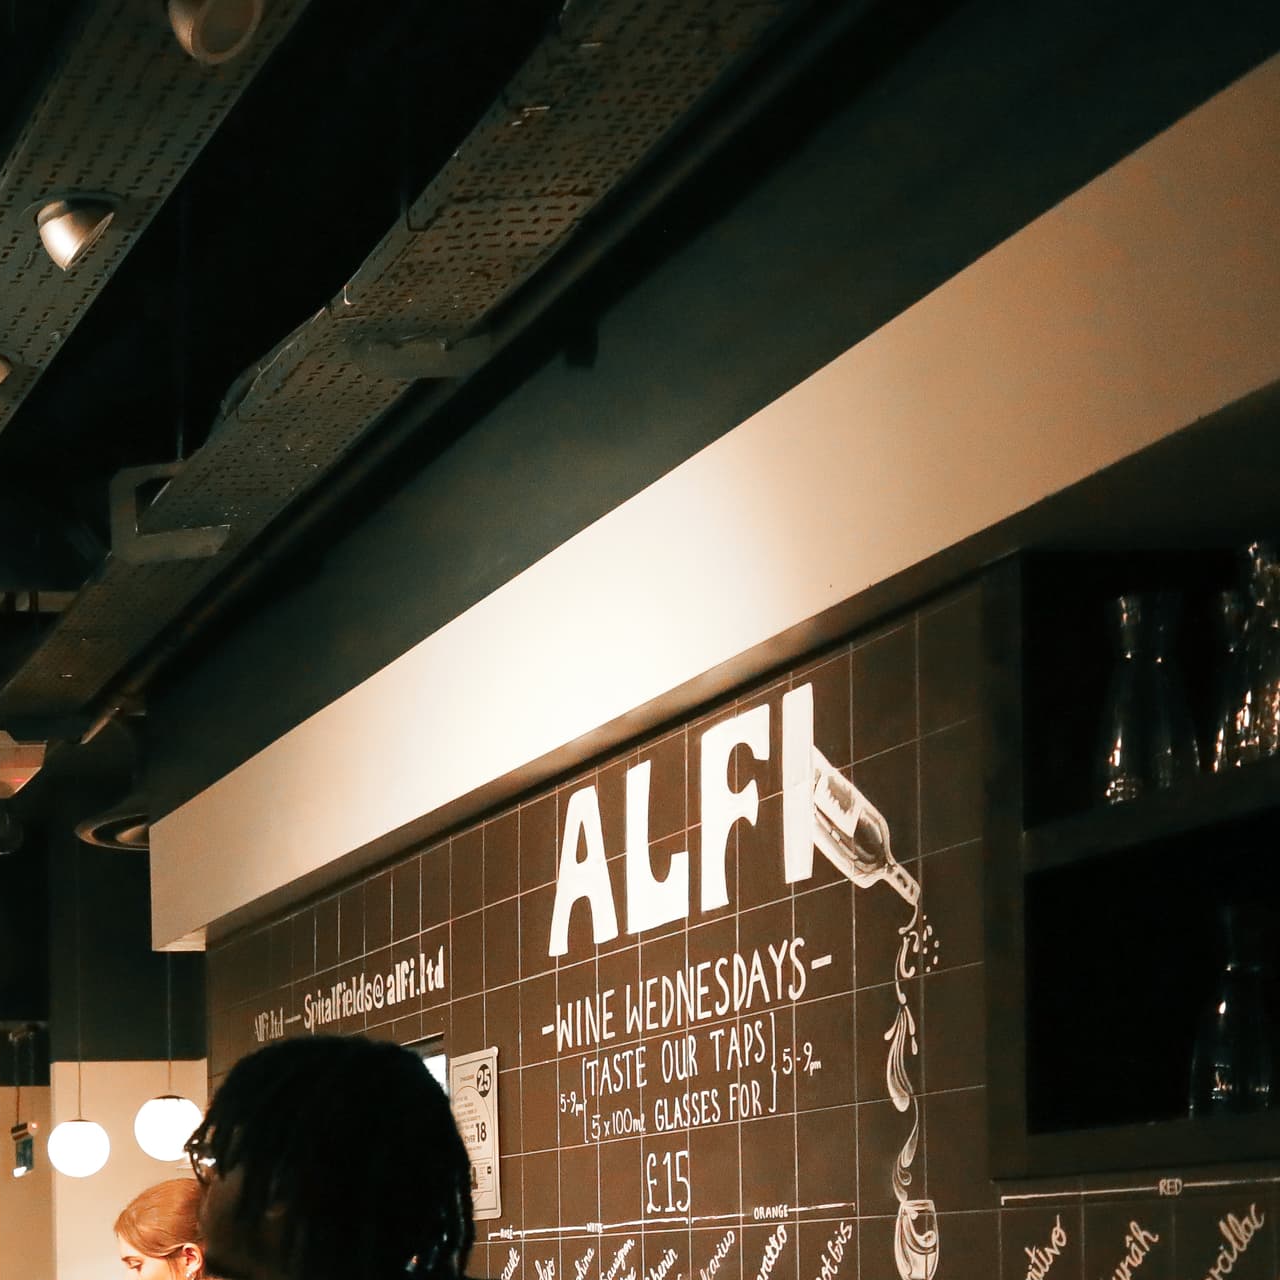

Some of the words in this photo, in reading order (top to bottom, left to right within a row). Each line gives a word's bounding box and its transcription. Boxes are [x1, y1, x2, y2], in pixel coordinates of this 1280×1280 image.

[548, 682, 814, 957] ALFI
[586, 1046, 647, 1097] TASTE
[661, 1034, 699, 1084] OUR
[710, 1019, 766, 1072] TAPS
[477, 1068, 491, 1092] 25
[654, 1088, 721, 1132] GLASSES
[729, 1080, 763, 1121] FOR
[476, 1121, 487, 1142] 18
[646, 1150, 690, 1214] £15
[1158, 1178, 1183, 1196] RED
[753, 1204, 789, 1220] ORANGE
[827, 1221, 853, 1263] Gris
